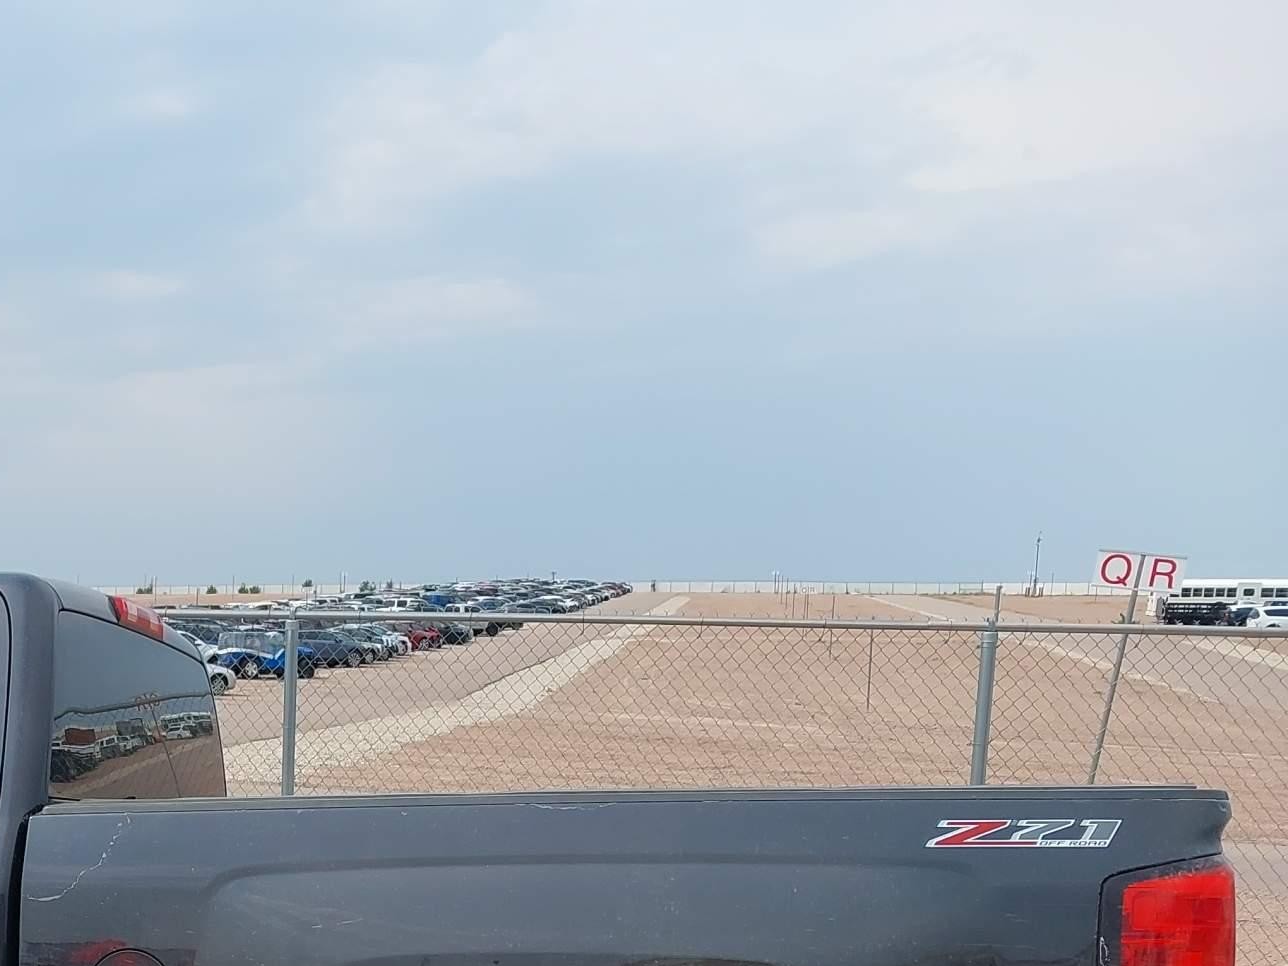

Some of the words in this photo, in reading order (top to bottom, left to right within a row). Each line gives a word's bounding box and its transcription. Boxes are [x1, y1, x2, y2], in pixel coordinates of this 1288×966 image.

[1101, 554, 1132, 587] Q
[1148, 558, 1177, 589] R
[925, 819, 1123, 848] Z71
[1038, 840, 1068, 848] OFF
[1071, 840, 1109, 848] ROAD
